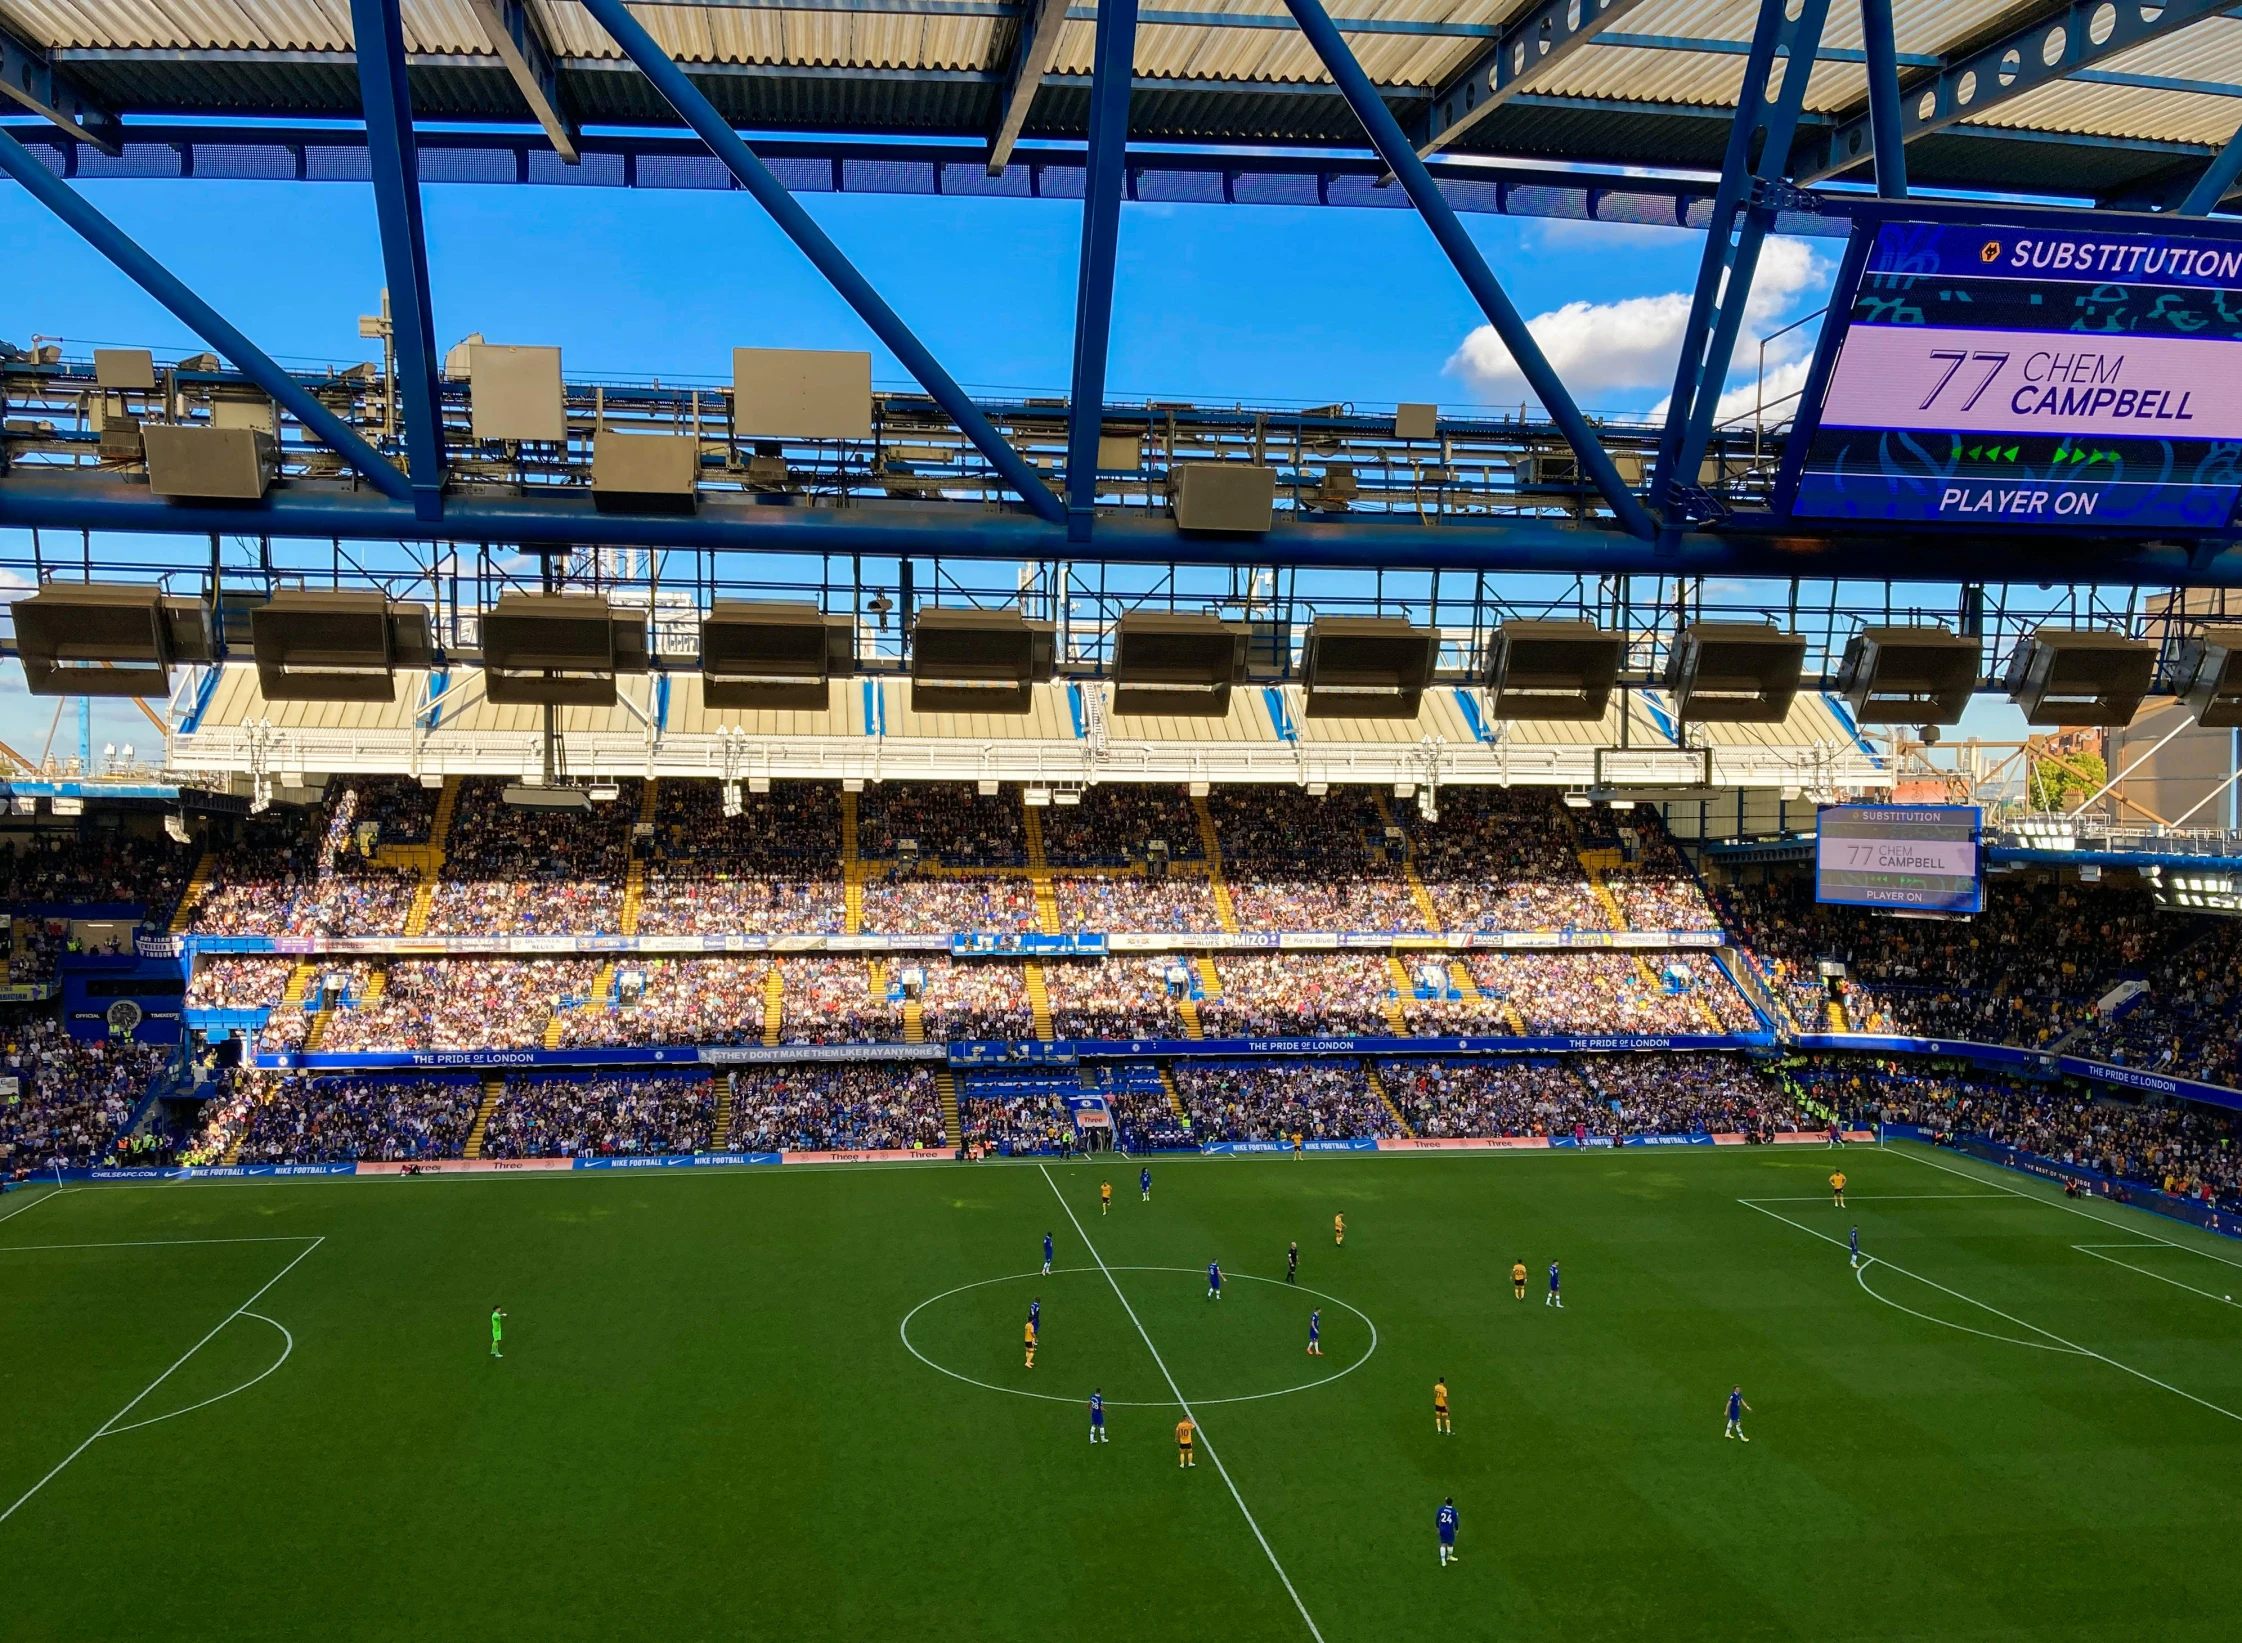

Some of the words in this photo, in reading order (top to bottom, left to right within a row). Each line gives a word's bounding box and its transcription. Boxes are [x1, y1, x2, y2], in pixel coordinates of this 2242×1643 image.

[2010, 240, 2242, 279] SUBSTITUTION
[2022, 351, 2125, 385] CHEM
[1918, 348, 2010, 412] 77
[2011, 385, 2194, 420] CAMPBELL
[1939, 488, 2049, 515] PLAYER
[2053, 490, 2099, 516] ON
[1862, 811, 1941, 822] SUBSTITUTION
[1847, 845, 1874, 865] 77
[1878, 845, 1913, 856] CHEM
[1878, 856, 1946, 869] CAMPBELL
[1866, 890, 1904, 901] PLAYER
[1906, 892, 1922, 902] ON
[1234, 935, 1268, 946] MIZO
[1249, 1042, 1268, 1050] THE
[1270, 1042, 1299, 1050] PRIDE
[1301, 1042, 1311, 1050] OF
[1312, 1041, 1354, 1050] LONDON
[1570, 1040, 1588, 1048] THE
[1590, 1039, 1617, 1047] PRIDE
[1620, 1039, 1629, 1047] OF
[1630, 1038, 1670, 1046] LONDON
[413, 1055, 434, 1064] THE
[438, 1054, 470, 1064] PRIDE
[473, 1054, 484, 1062] OF
[486, 1053, 534, 1063] LONDON
[720, 1050, 748, 1060] THEY
[750, 1050, 779, 1060] DON'T
[780, 1049, 810, 1058] MAKE
[812, 1048, 839, 1058] THEM
[840, 1048, 862, 1057] LIKE
[862, 1048, 884, 1057] RAY
[884, 1047, 933, 1056] ANYMORE
[2088, 1066, 2104, 1078] THE
[2105, 1069, 2129, 1083] PRIDE
[2130, 1075, 2139, 1084] OF
[2140, 1076, 2176, 1092] LONDON
[612, 1159, 628, 1167] NIKE
[630, 1158, 662, 1166] FOOTBALL
[712, 1156, 744, 1164] FOOTBALL
[2035, 1165, 2048, 1174] BEST
[2050, 1169, 2058, 1177] OF
[2058, 1172, 2070, 1181] THE
[2233, 1225, 2242, 1233] TH
[1092, 1400, 1099, 1410] 28
[1181, 1428, 1188, 1437] 10
[1440, 1512, 1452, 1524] 24
